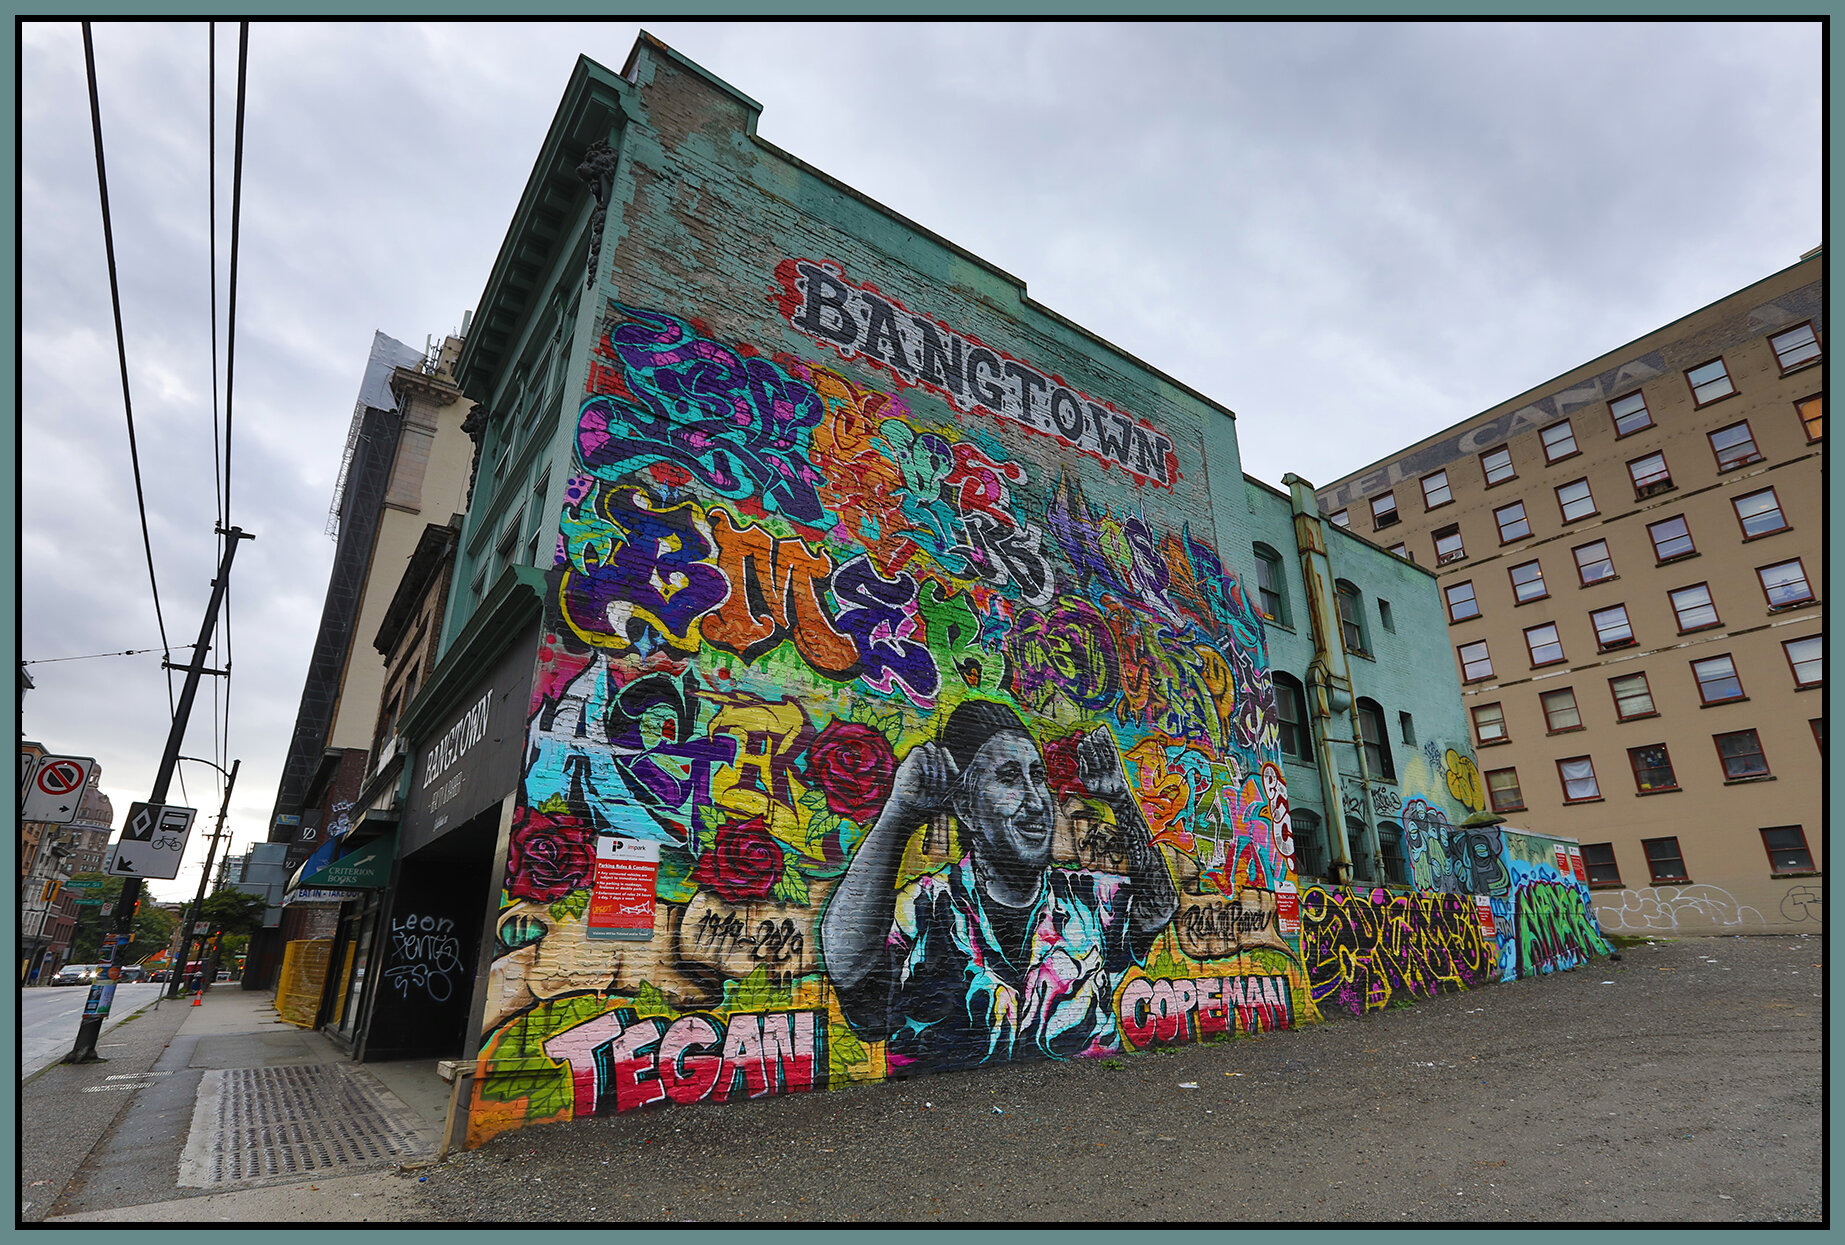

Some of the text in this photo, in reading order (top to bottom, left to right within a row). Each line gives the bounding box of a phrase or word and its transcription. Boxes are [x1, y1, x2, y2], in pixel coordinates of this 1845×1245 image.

[799, 263, 1171, 484] BANGTOWN
[422, 688, 494, 790] BANGTOWN
[328, 867, 375, 876] CRITERION
[392, 914, 455, 933] Leon
[1121, 975, 1292, 1046] COPEMAN
[544, 1008, 817, 1115] TEGAN
